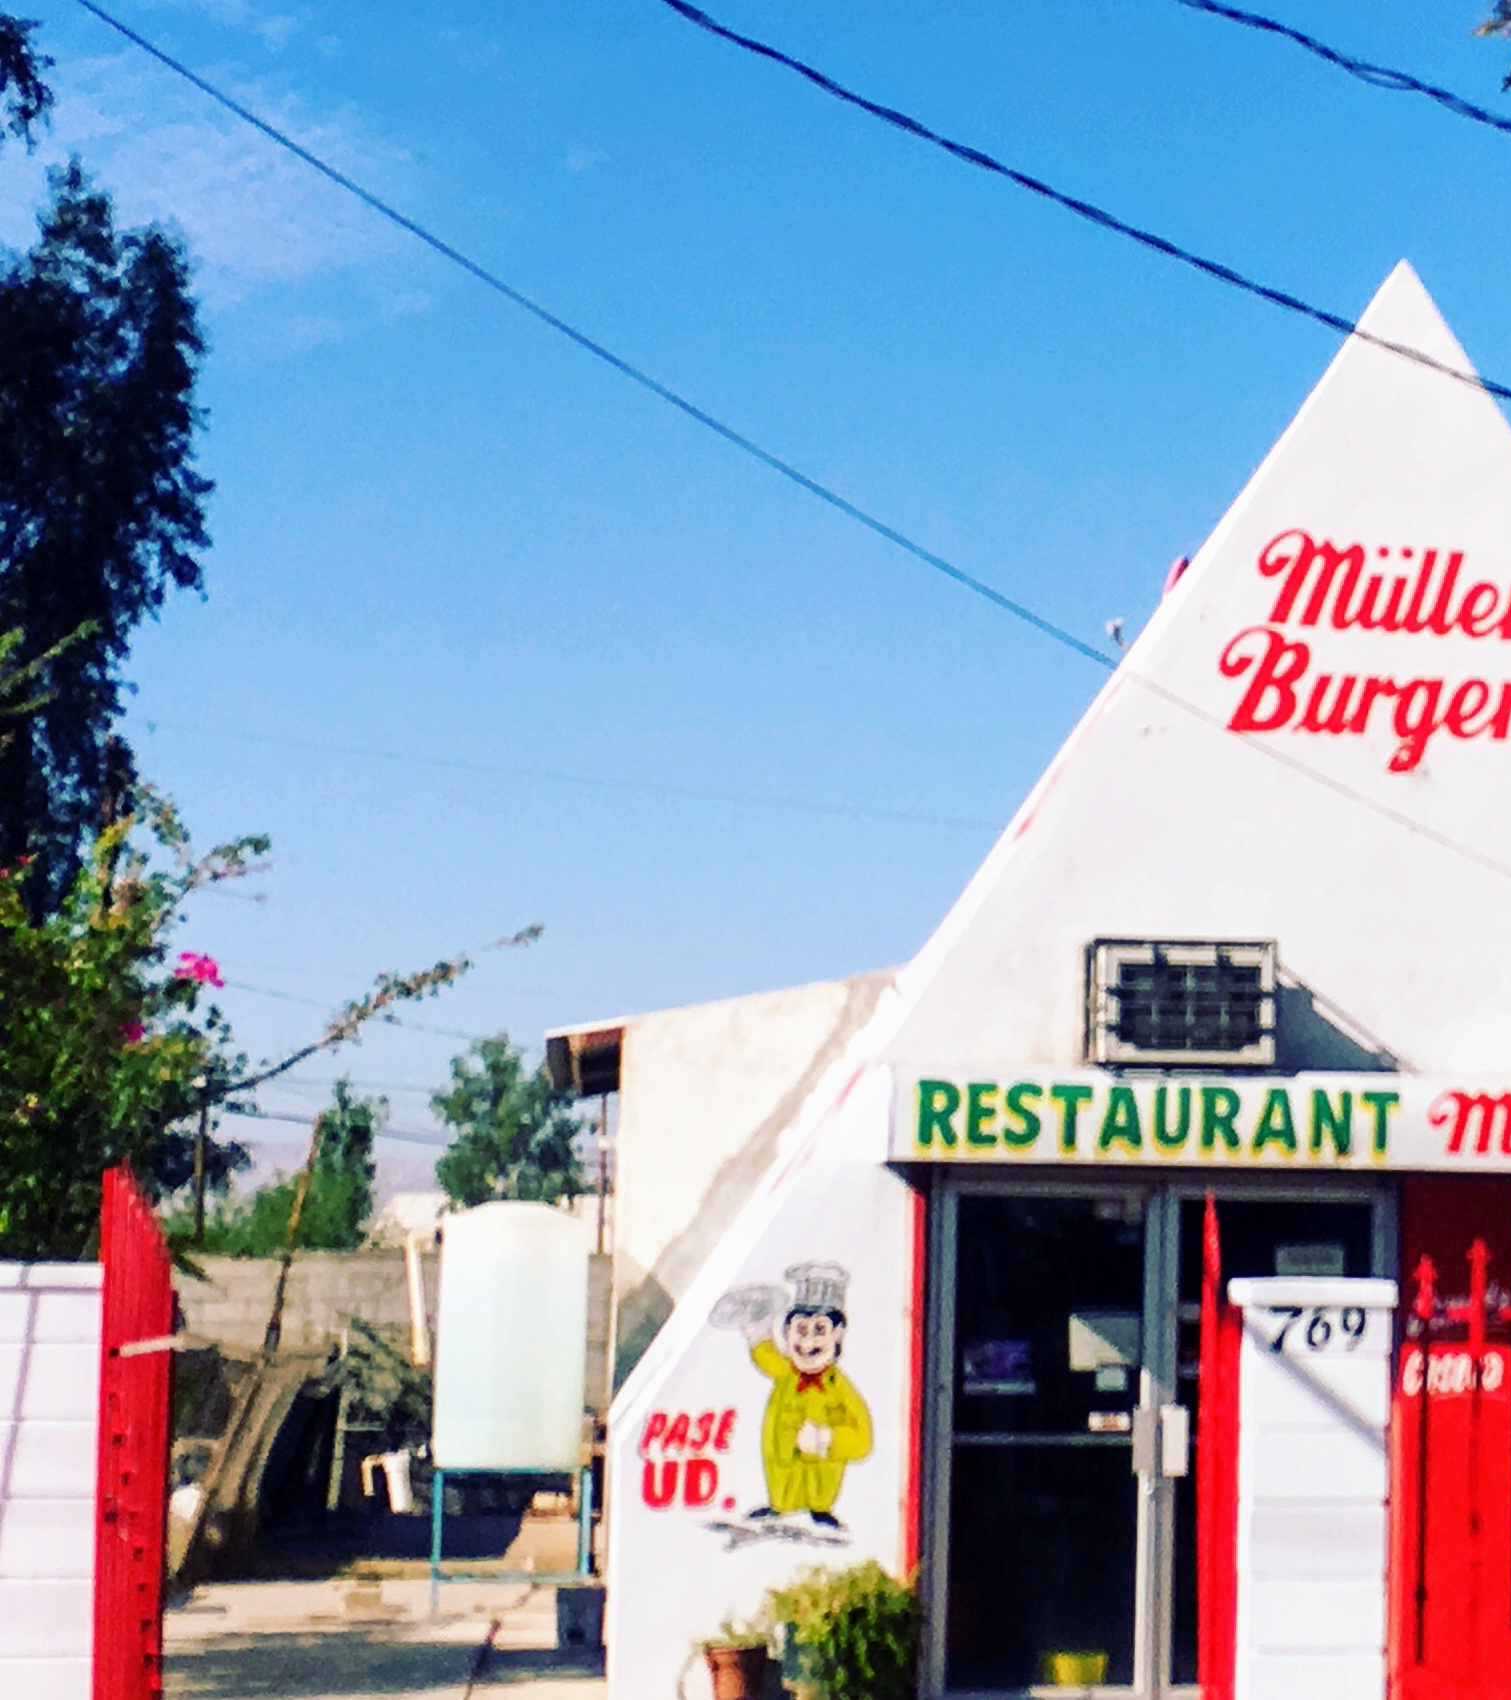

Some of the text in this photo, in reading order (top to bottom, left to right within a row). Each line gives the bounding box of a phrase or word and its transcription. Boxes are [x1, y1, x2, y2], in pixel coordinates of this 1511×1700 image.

[915, 1079, 1400, 1158] RESTAURANT
[1269, 1305, 1366, 1353] 769
[641, 1458, 736, 1509] UD.
